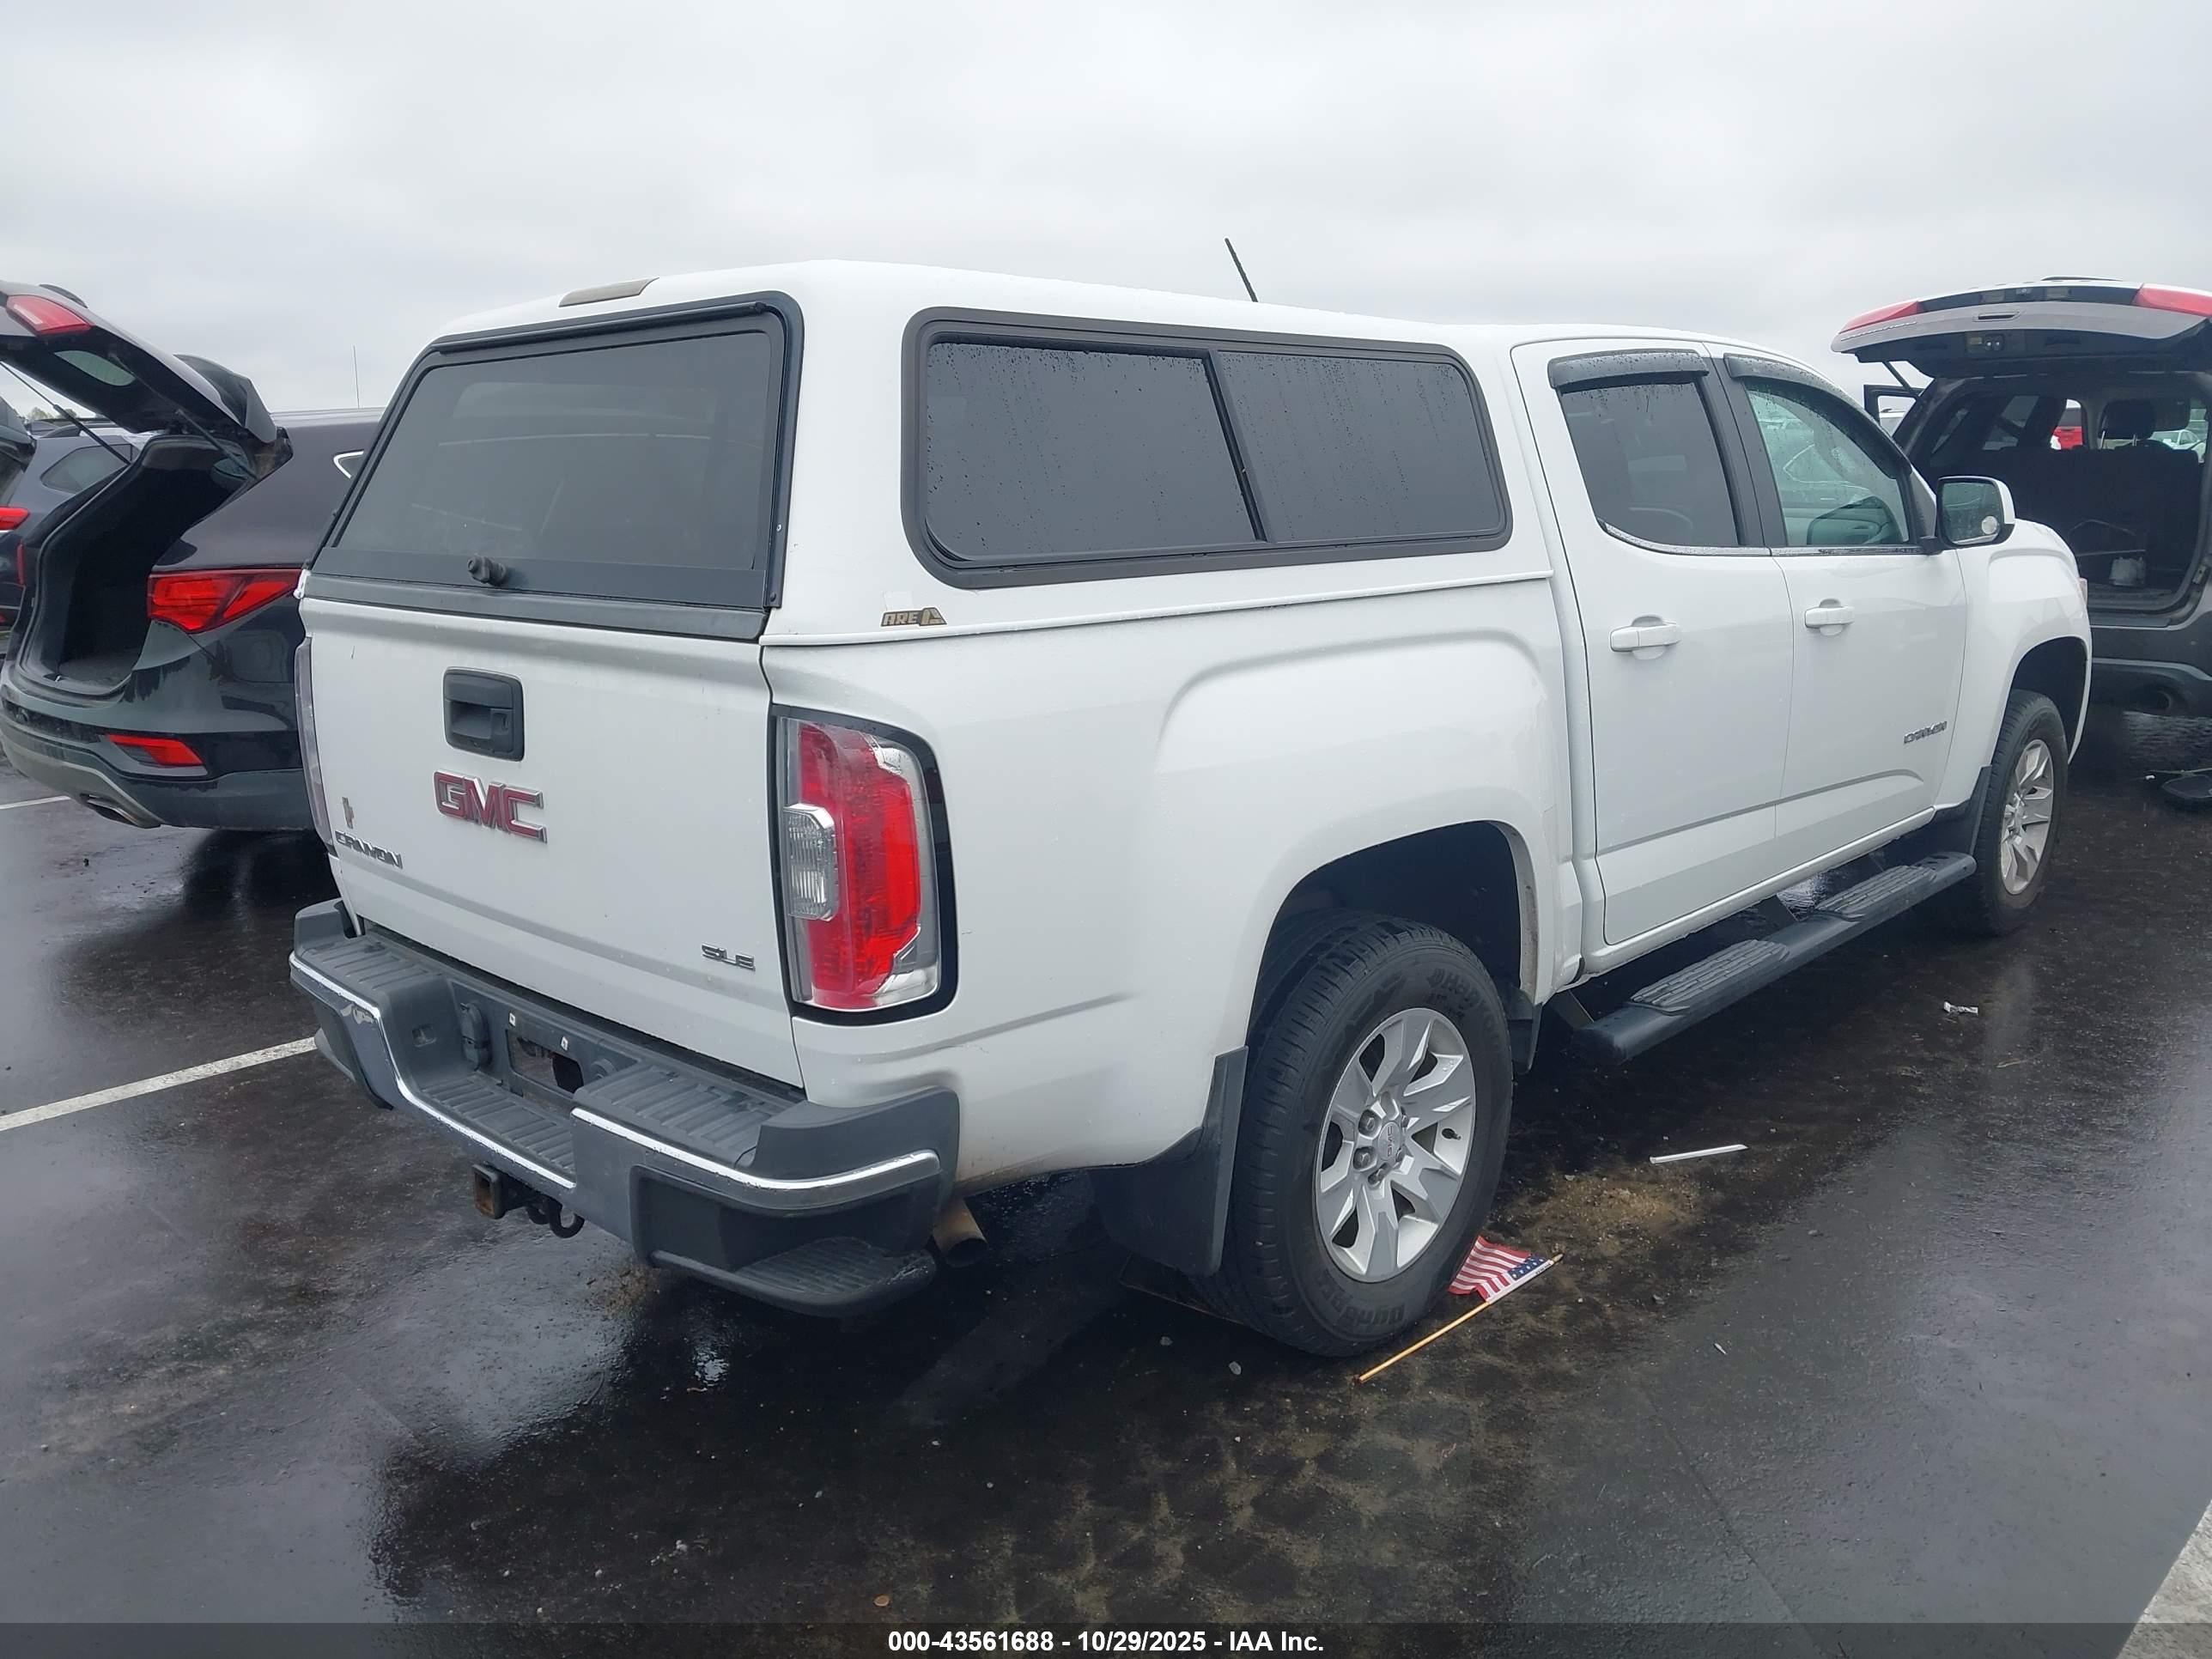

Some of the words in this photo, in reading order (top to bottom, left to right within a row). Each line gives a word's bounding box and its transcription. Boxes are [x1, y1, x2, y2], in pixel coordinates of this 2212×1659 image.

[433, 769, 547, 843] GMC
[701, 942, 757, 972] SLE
[1386, 1125, 1395, 1158] GMC
